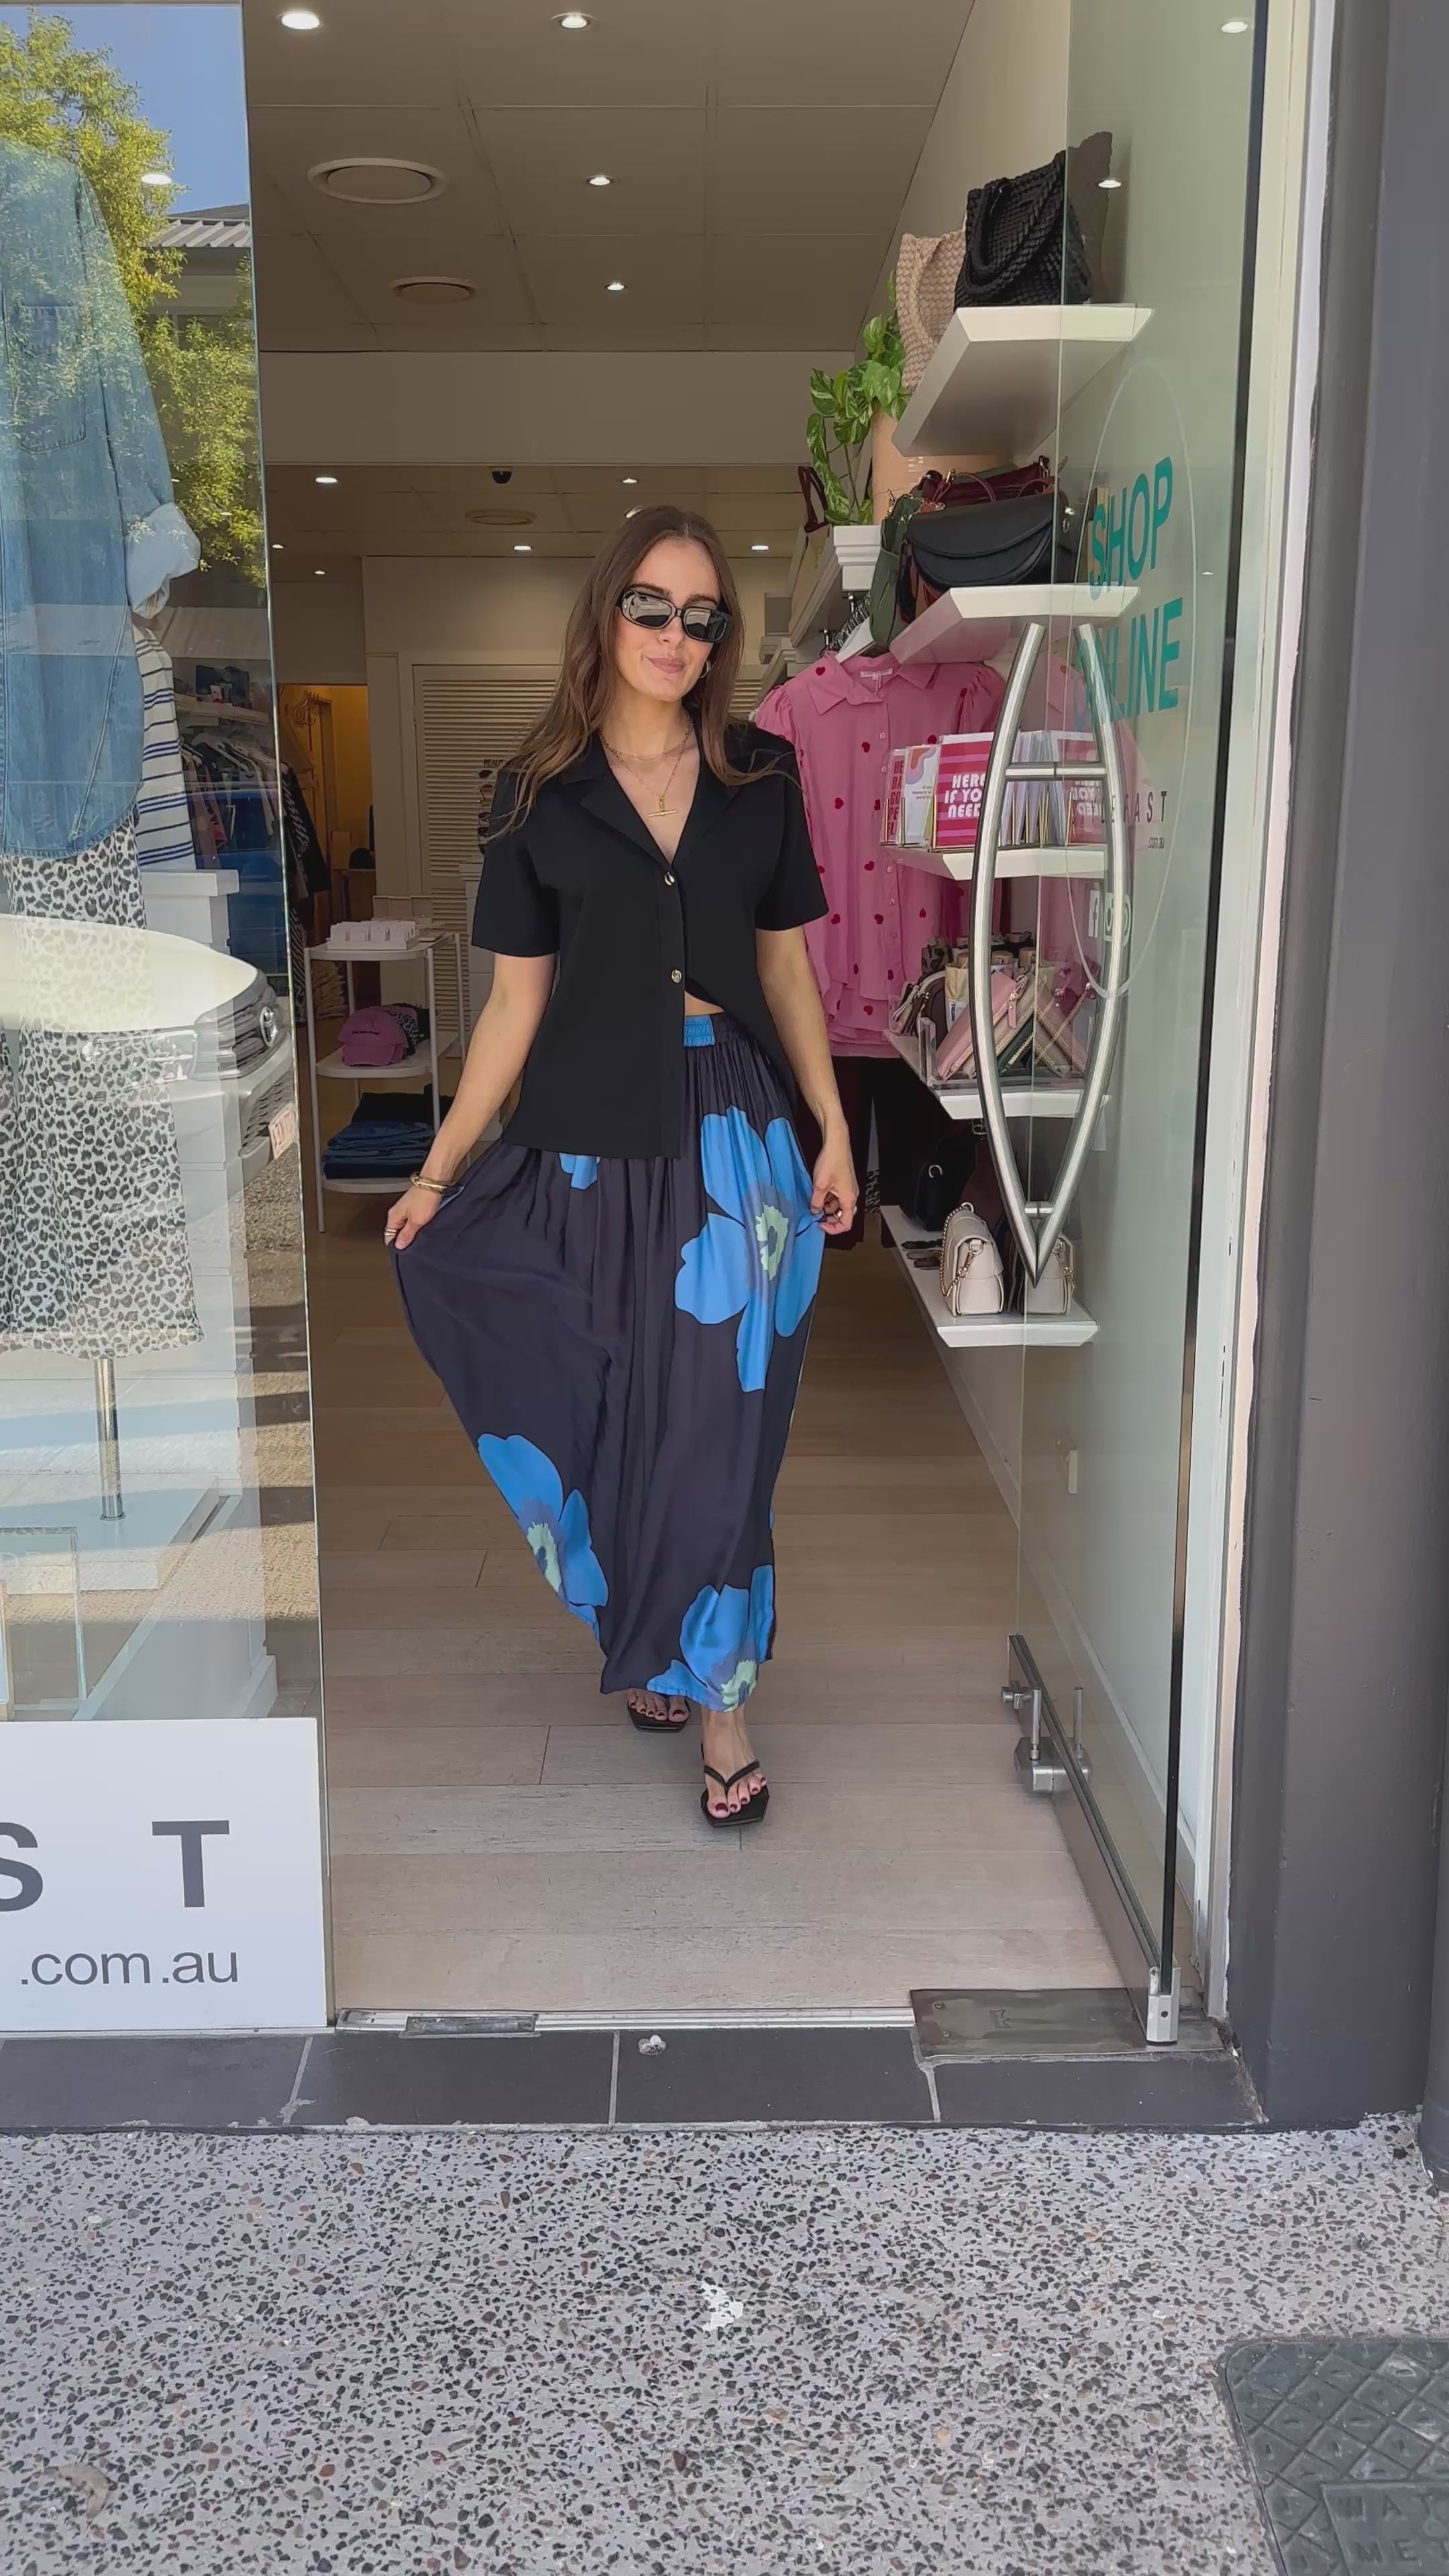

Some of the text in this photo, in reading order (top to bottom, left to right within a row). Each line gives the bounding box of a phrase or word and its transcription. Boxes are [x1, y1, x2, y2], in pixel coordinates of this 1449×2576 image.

[1088, 455, 1173, 601] SHOP
[1074, 596, 1183, 731] ONLINE
[944, 790, 959, 804] IF
[961, 788, 983, 803] YO
[21, 1951, 238, 1985] .com.au
